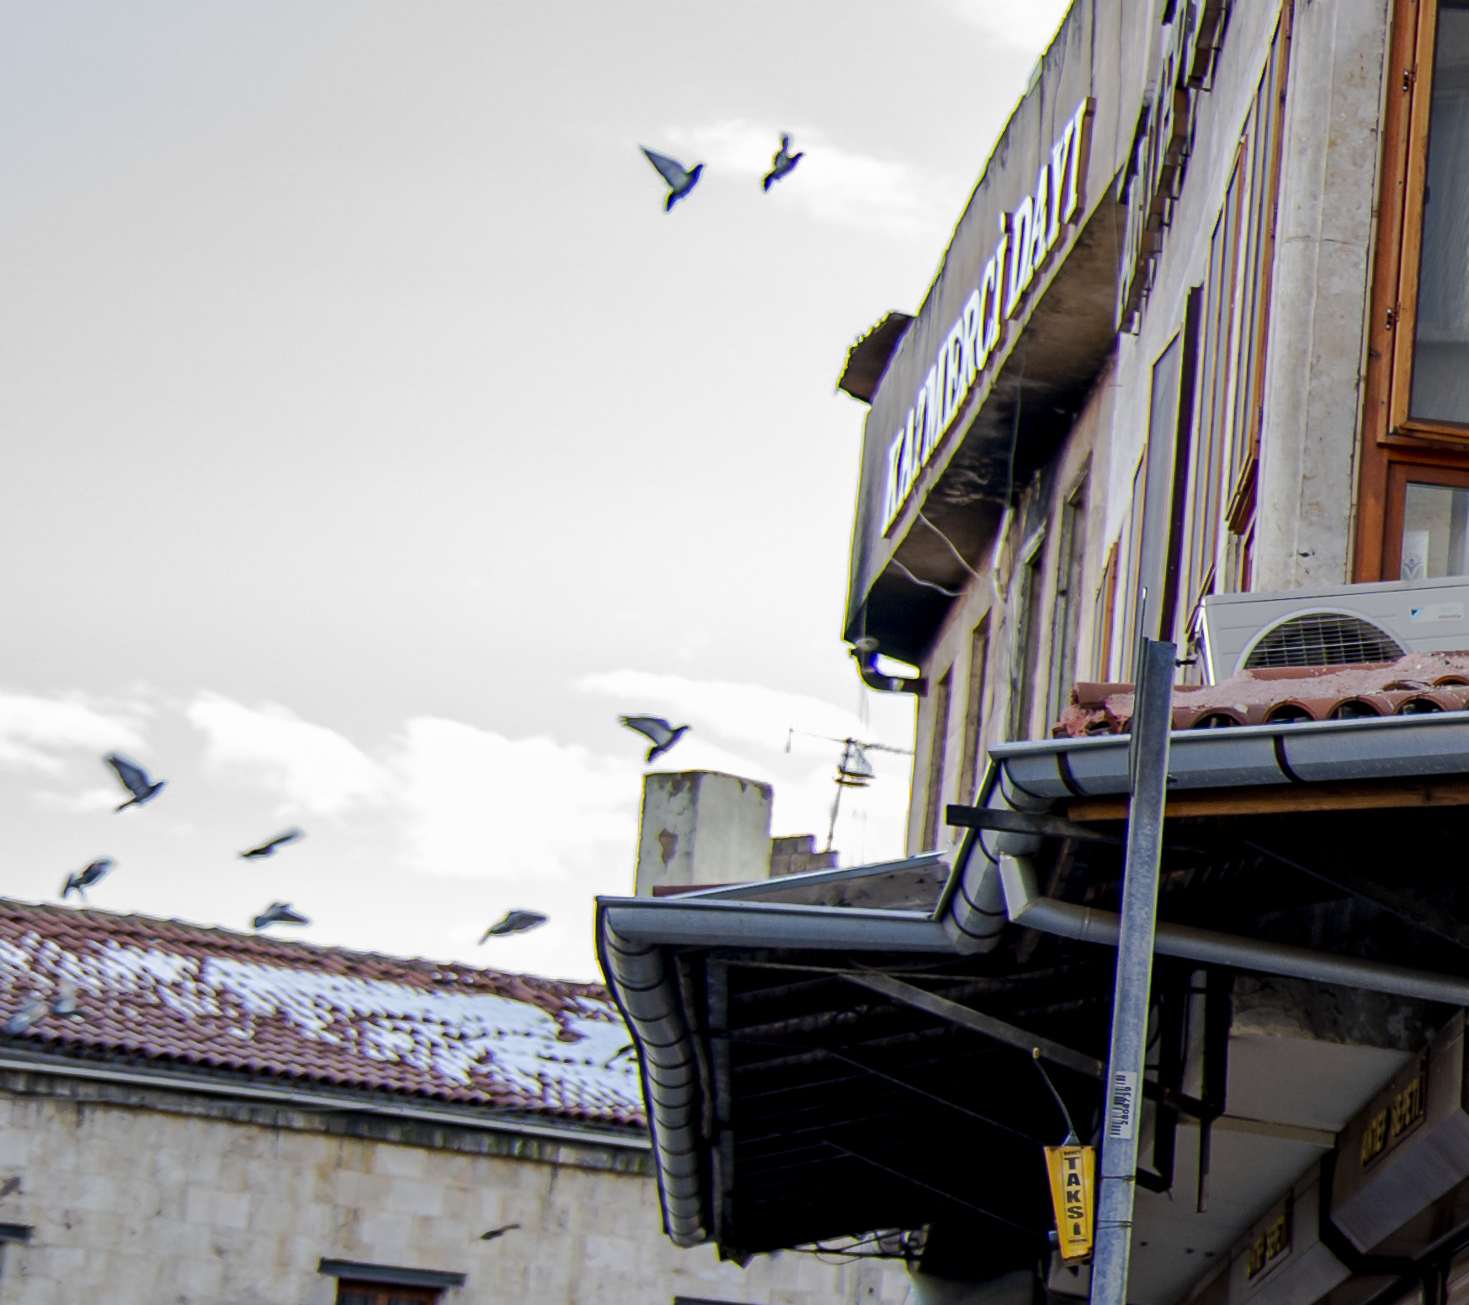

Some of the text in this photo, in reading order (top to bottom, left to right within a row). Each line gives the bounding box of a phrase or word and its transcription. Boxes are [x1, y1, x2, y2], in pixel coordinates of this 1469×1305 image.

[881, 96, 1095, 539] KATMERCİ DAYI
[1063, 1156, 1085, 1236] TAKSİ
